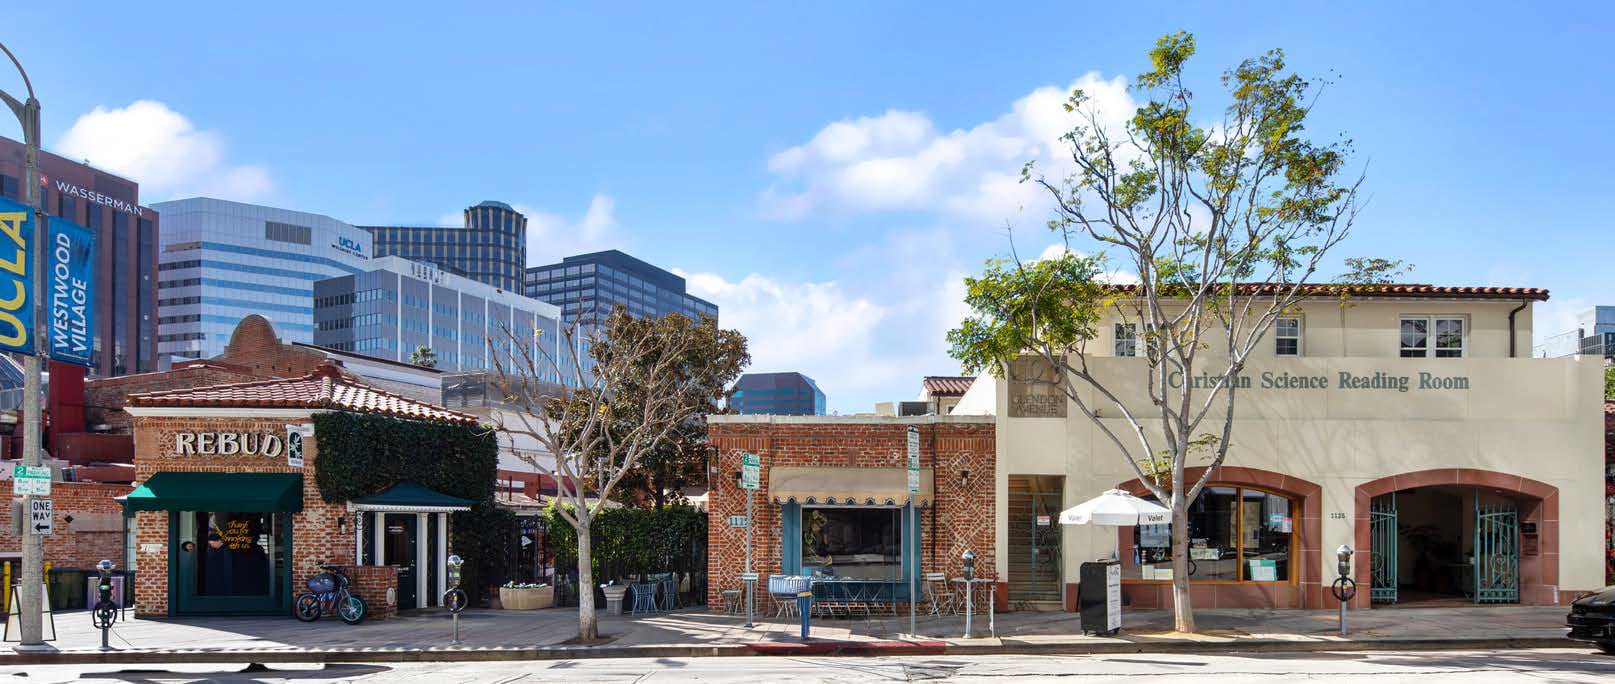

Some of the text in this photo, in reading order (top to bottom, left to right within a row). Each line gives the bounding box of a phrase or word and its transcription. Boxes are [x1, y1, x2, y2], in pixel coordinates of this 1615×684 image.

[55, 180, 143, 216] WASSERMAN
[338, 236, 362, 252] UCLA
[0, 211, 27, 347] UCLA
[54, 233, 71, 349] WESTWOOD
[72, 277, 87, 352] VILLAGE
[1168, 371, 1470, 392] Cristian Science Reading Room
[176, 432, 283, 458] REBUD
[33, 502, 50, 510] ONE
[33, 512, 50, 520] WAY
[1147, 514, 1163, 522] Valet
